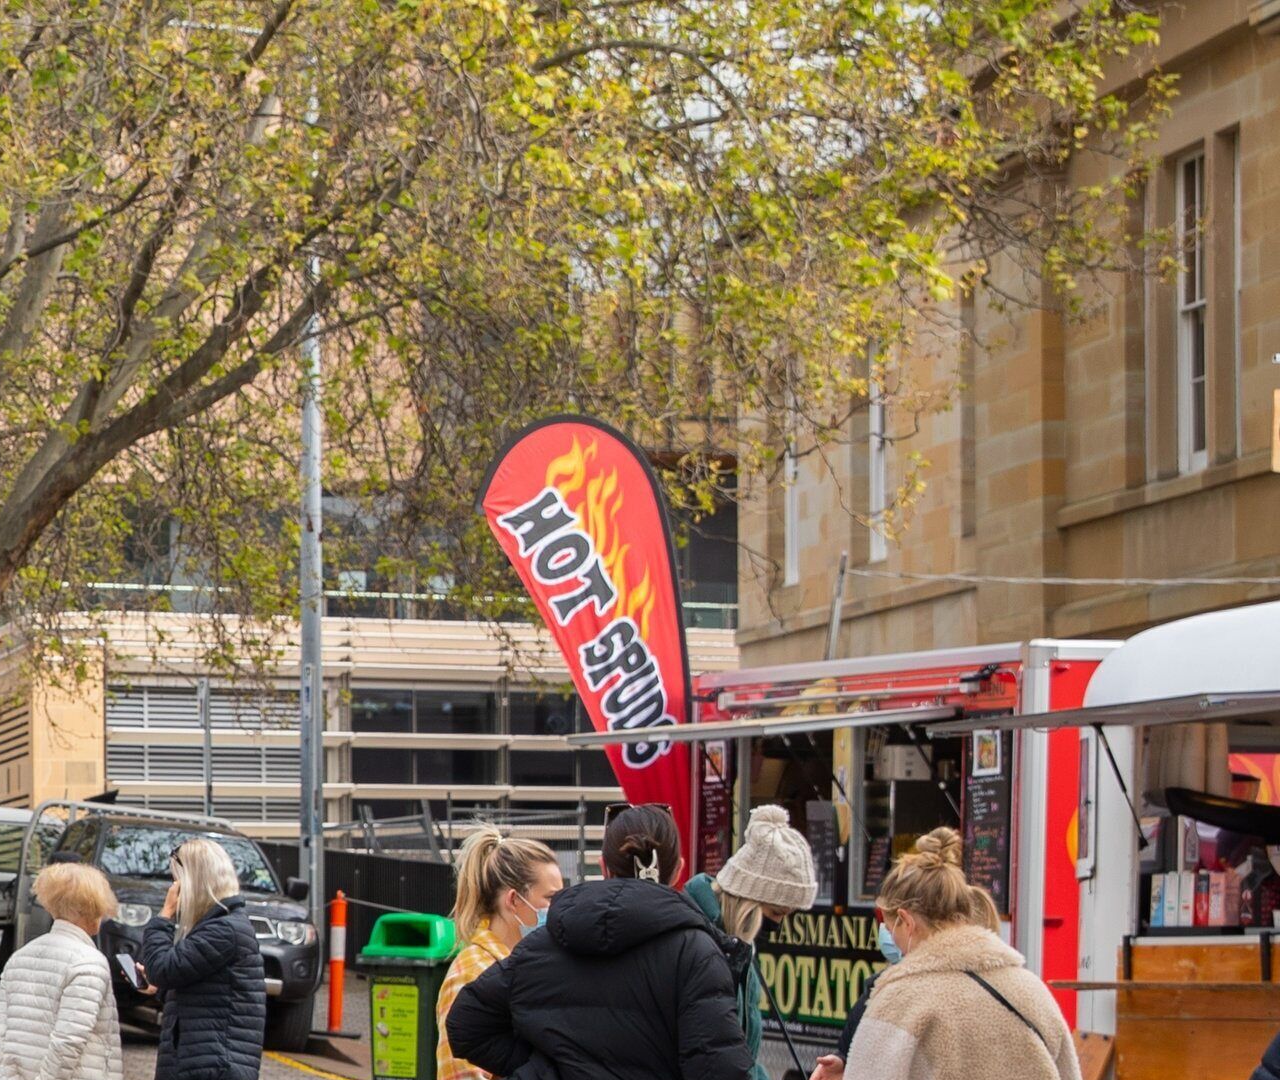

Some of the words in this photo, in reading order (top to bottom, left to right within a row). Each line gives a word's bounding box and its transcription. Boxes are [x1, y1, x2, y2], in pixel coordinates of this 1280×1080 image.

[496, 487, 618, 626] HOT
[578, 616, 679, 769] SPUDS
[758, 953, 888, 1020] POTATO
